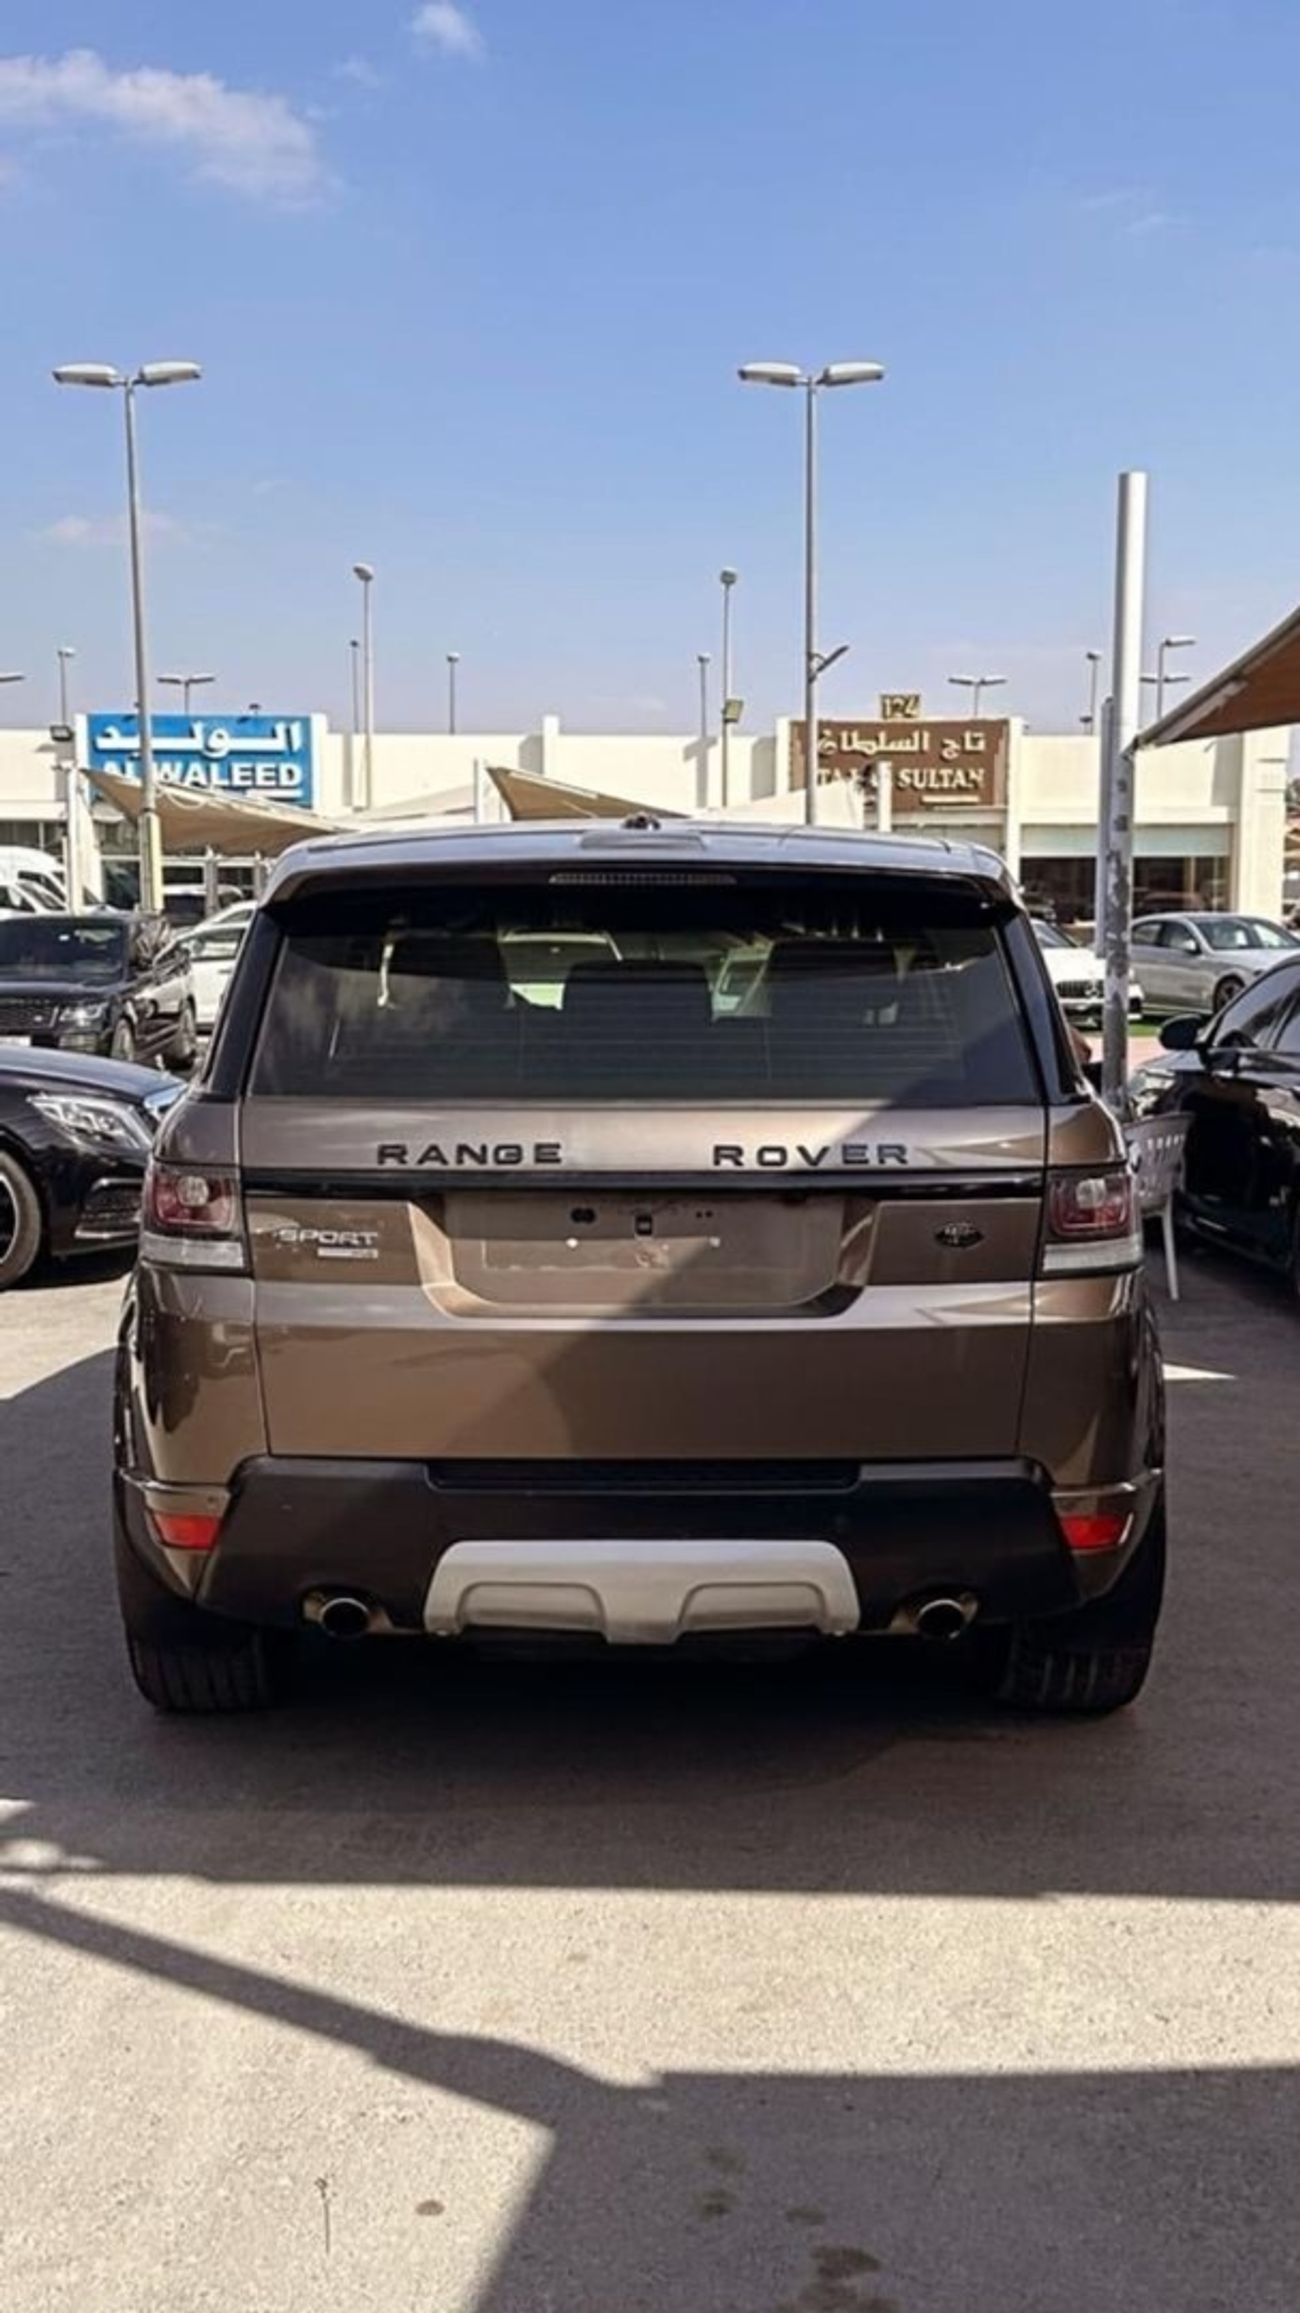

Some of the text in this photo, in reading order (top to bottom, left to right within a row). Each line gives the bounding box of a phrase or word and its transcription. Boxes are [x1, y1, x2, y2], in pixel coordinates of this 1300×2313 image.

[96, 721, 302, 758] الوليد
[941, 730, 985, 759] تاج
[899, 768, 985, 788] SULTAN
[377, 1143, 908, 1167] RANGE ROVER
[279, 1229, 378, 1245] SPORT
